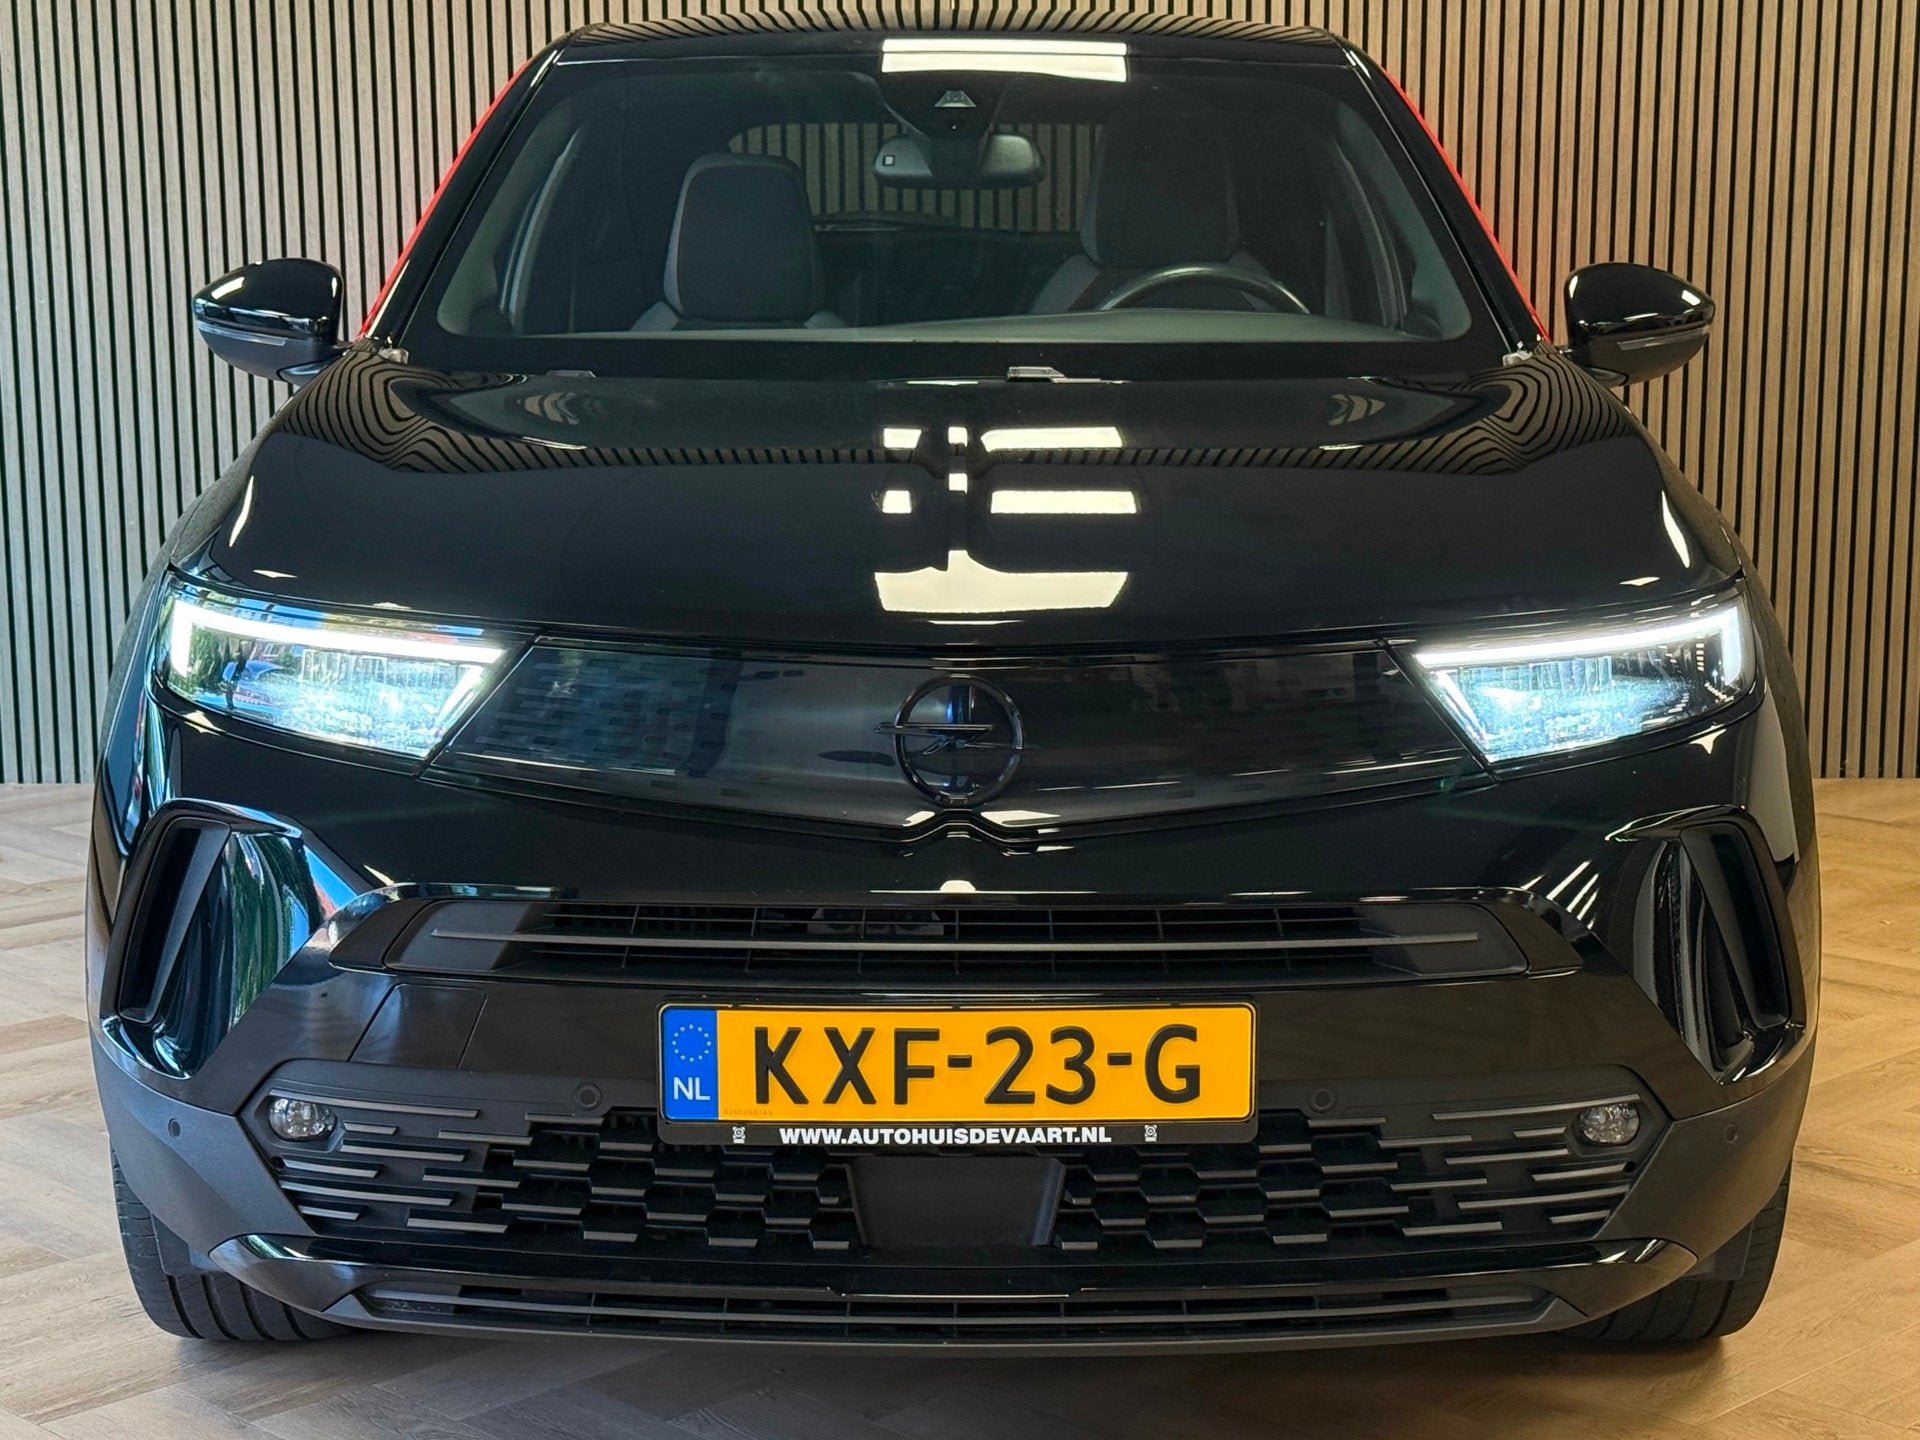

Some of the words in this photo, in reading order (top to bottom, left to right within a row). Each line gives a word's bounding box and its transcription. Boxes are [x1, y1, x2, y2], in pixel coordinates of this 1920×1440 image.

[754, 1024, 1200, 1105] KXF-23-G
[673, 1076, 711, 1101] NL
[779, 1127, 1112, 1144] WWW.AUTOHUISDEVAART.NL
